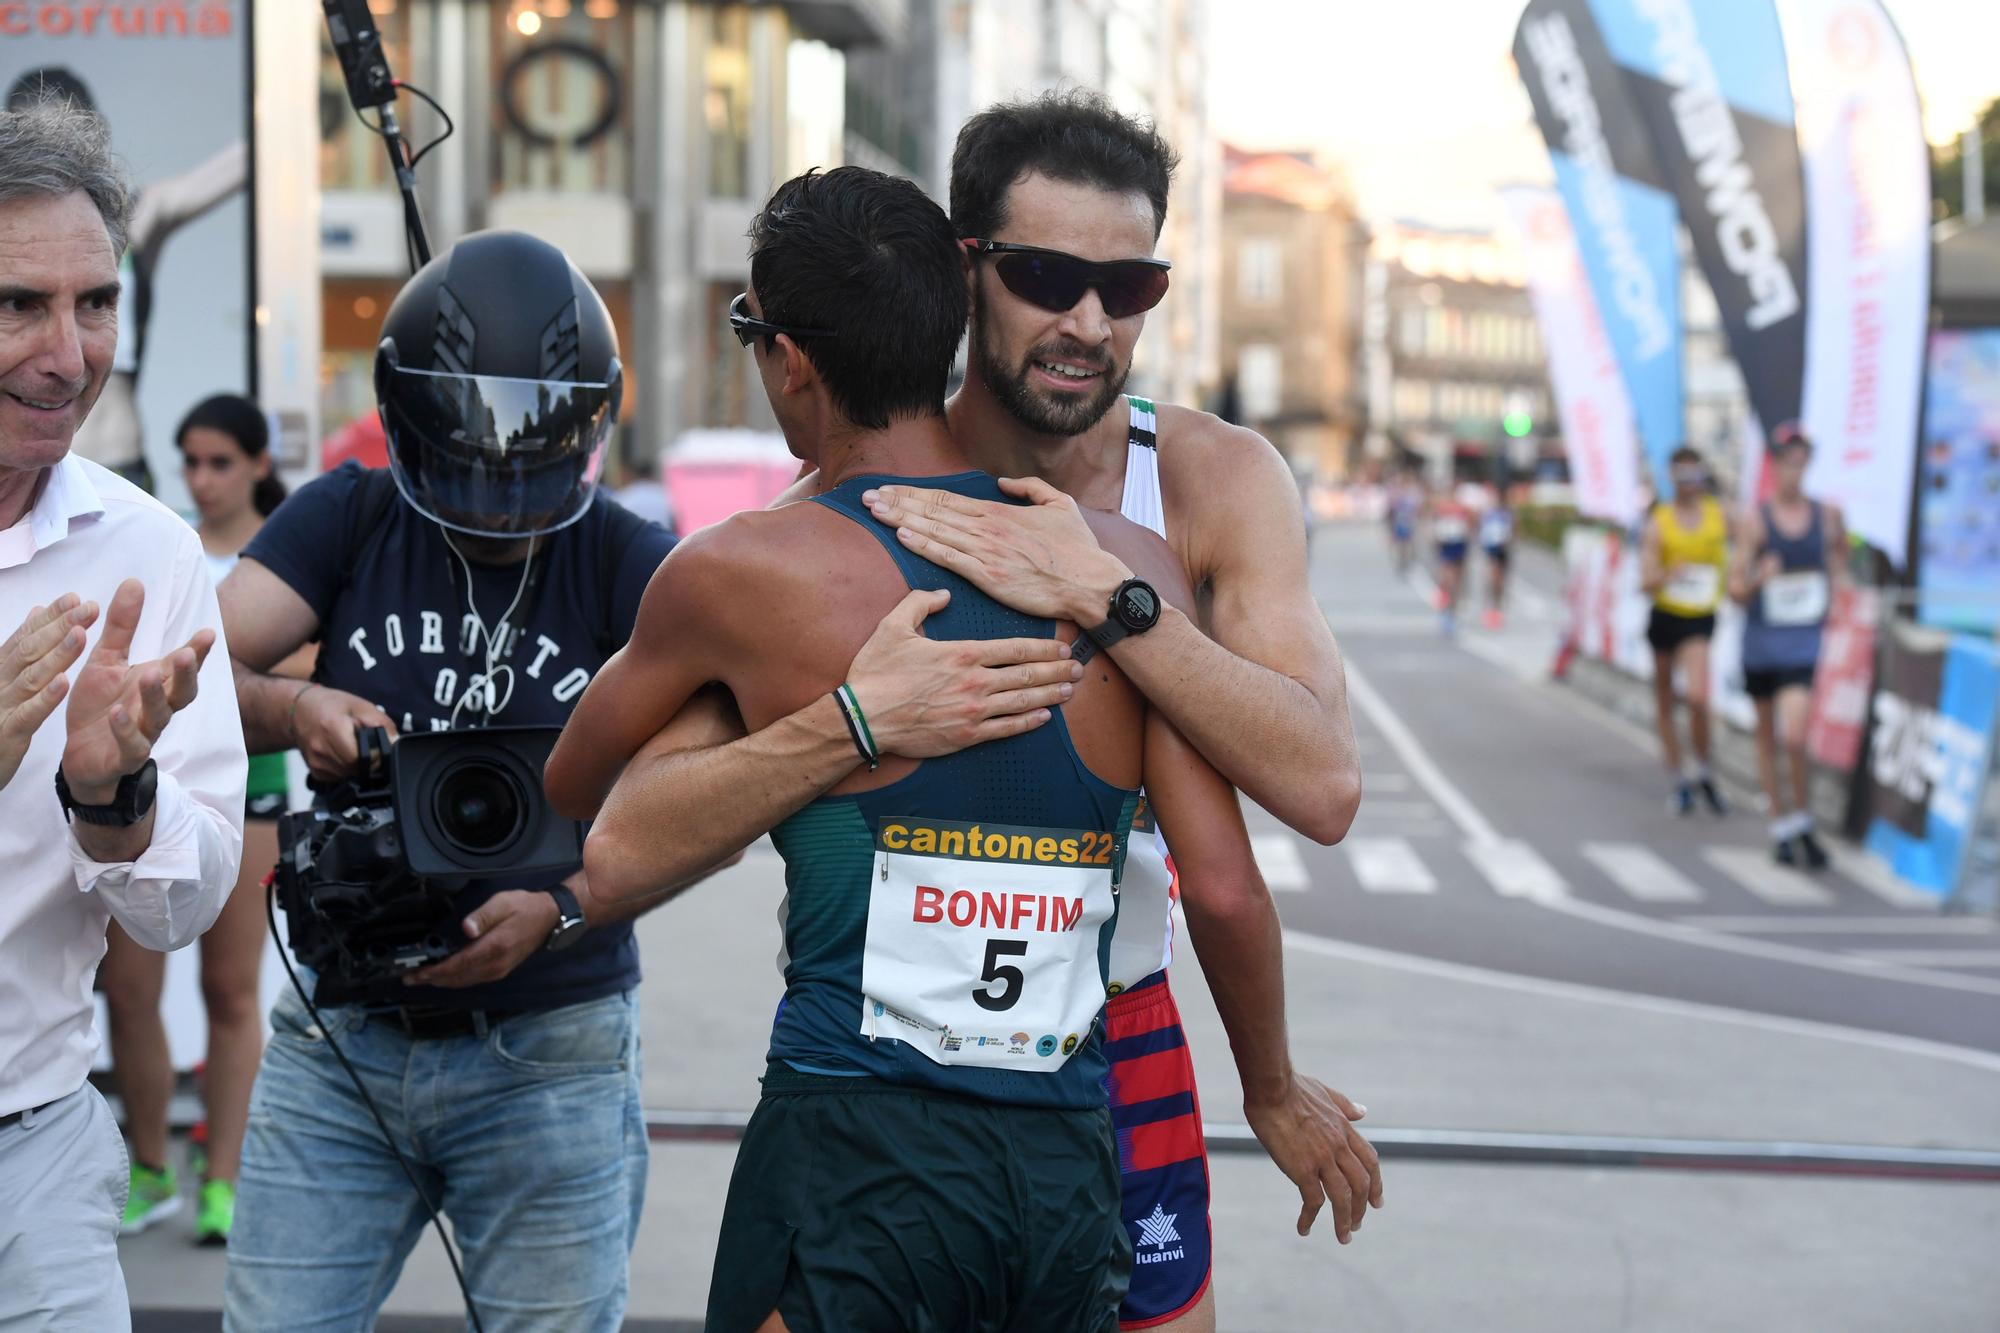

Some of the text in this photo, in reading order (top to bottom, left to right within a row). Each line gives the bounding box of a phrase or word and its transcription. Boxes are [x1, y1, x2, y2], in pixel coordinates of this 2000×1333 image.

[882, 824, 1113, 864] cantones22
[912, 885, 1083, 933] BONFIM
[972, 938, 1029, 1012] 5
[1135, 1245, 1185, 1265] luanvi
